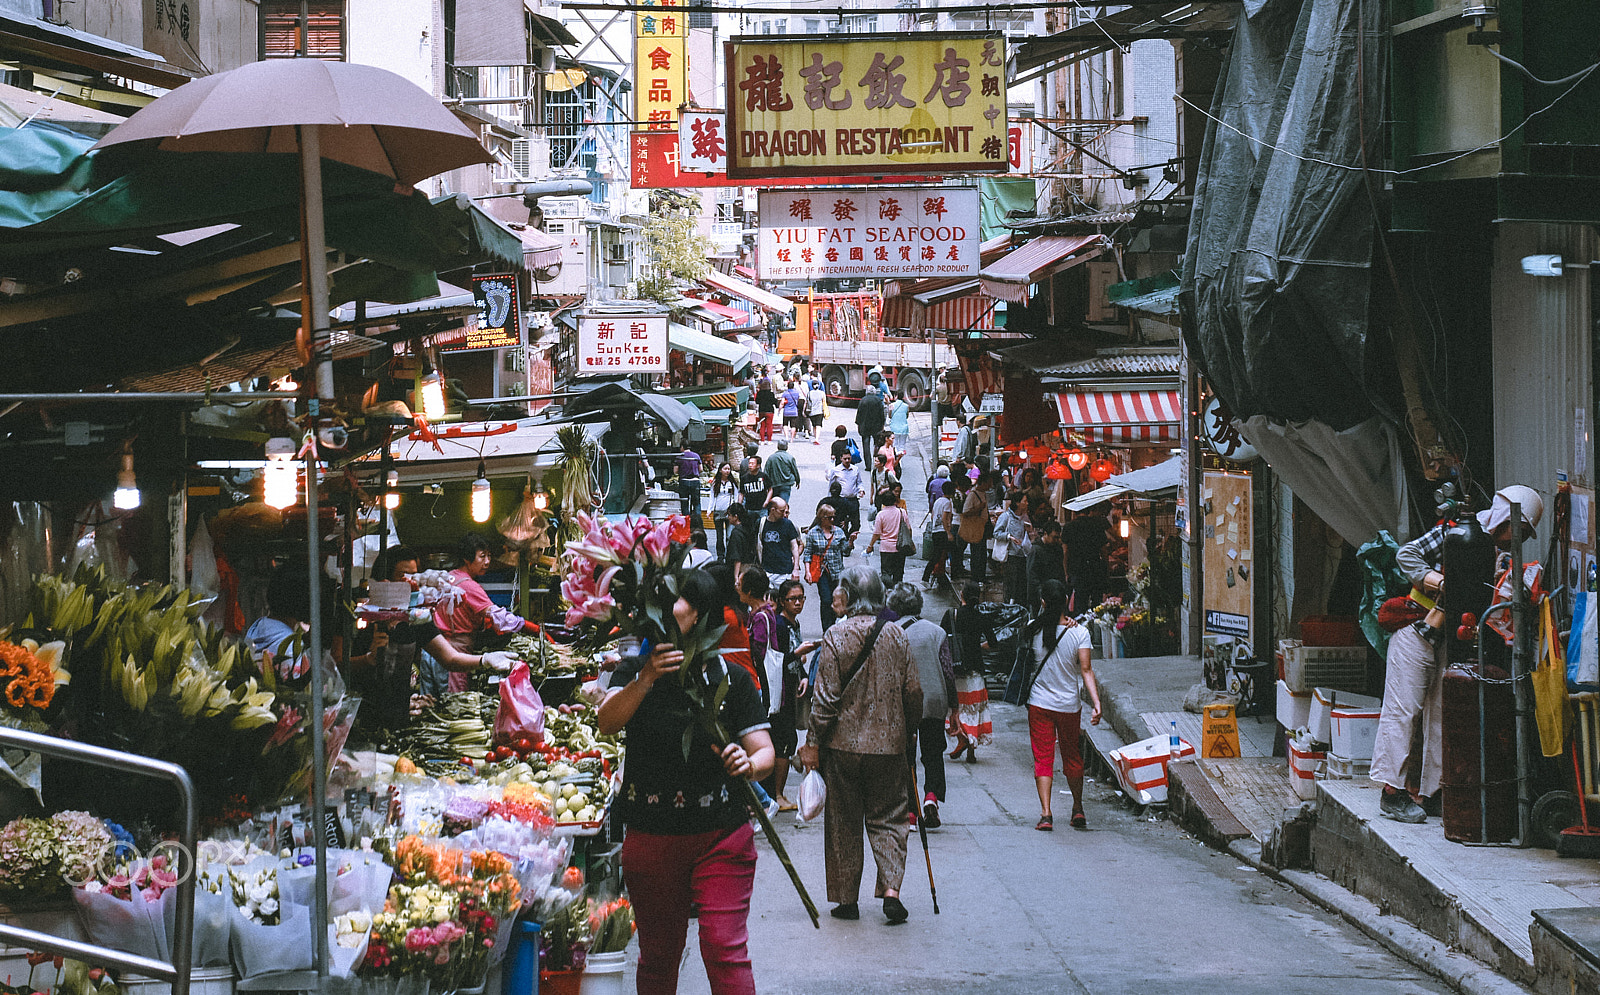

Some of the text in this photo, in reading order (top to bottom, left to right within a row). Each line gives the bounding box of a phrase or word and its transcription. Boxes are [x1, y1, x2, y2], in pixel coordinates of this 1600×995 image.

[739, 48, 972, 113] 龍記飯店
[741, 129, 827, 158] DRAGON
[789, 196, 948, 223] 耀發海鮮
[773, 226, 966, 244] YIU FAT SEAFOOD
[769, 264, 970, 275] THE BEST OF INTERNATIONAL FRESH SEAFOOD PRODUCT
[597, 322, 648, 340] 新記
[607, 357, 621, 366] 25
[628, 356, 661, 366] 47369
